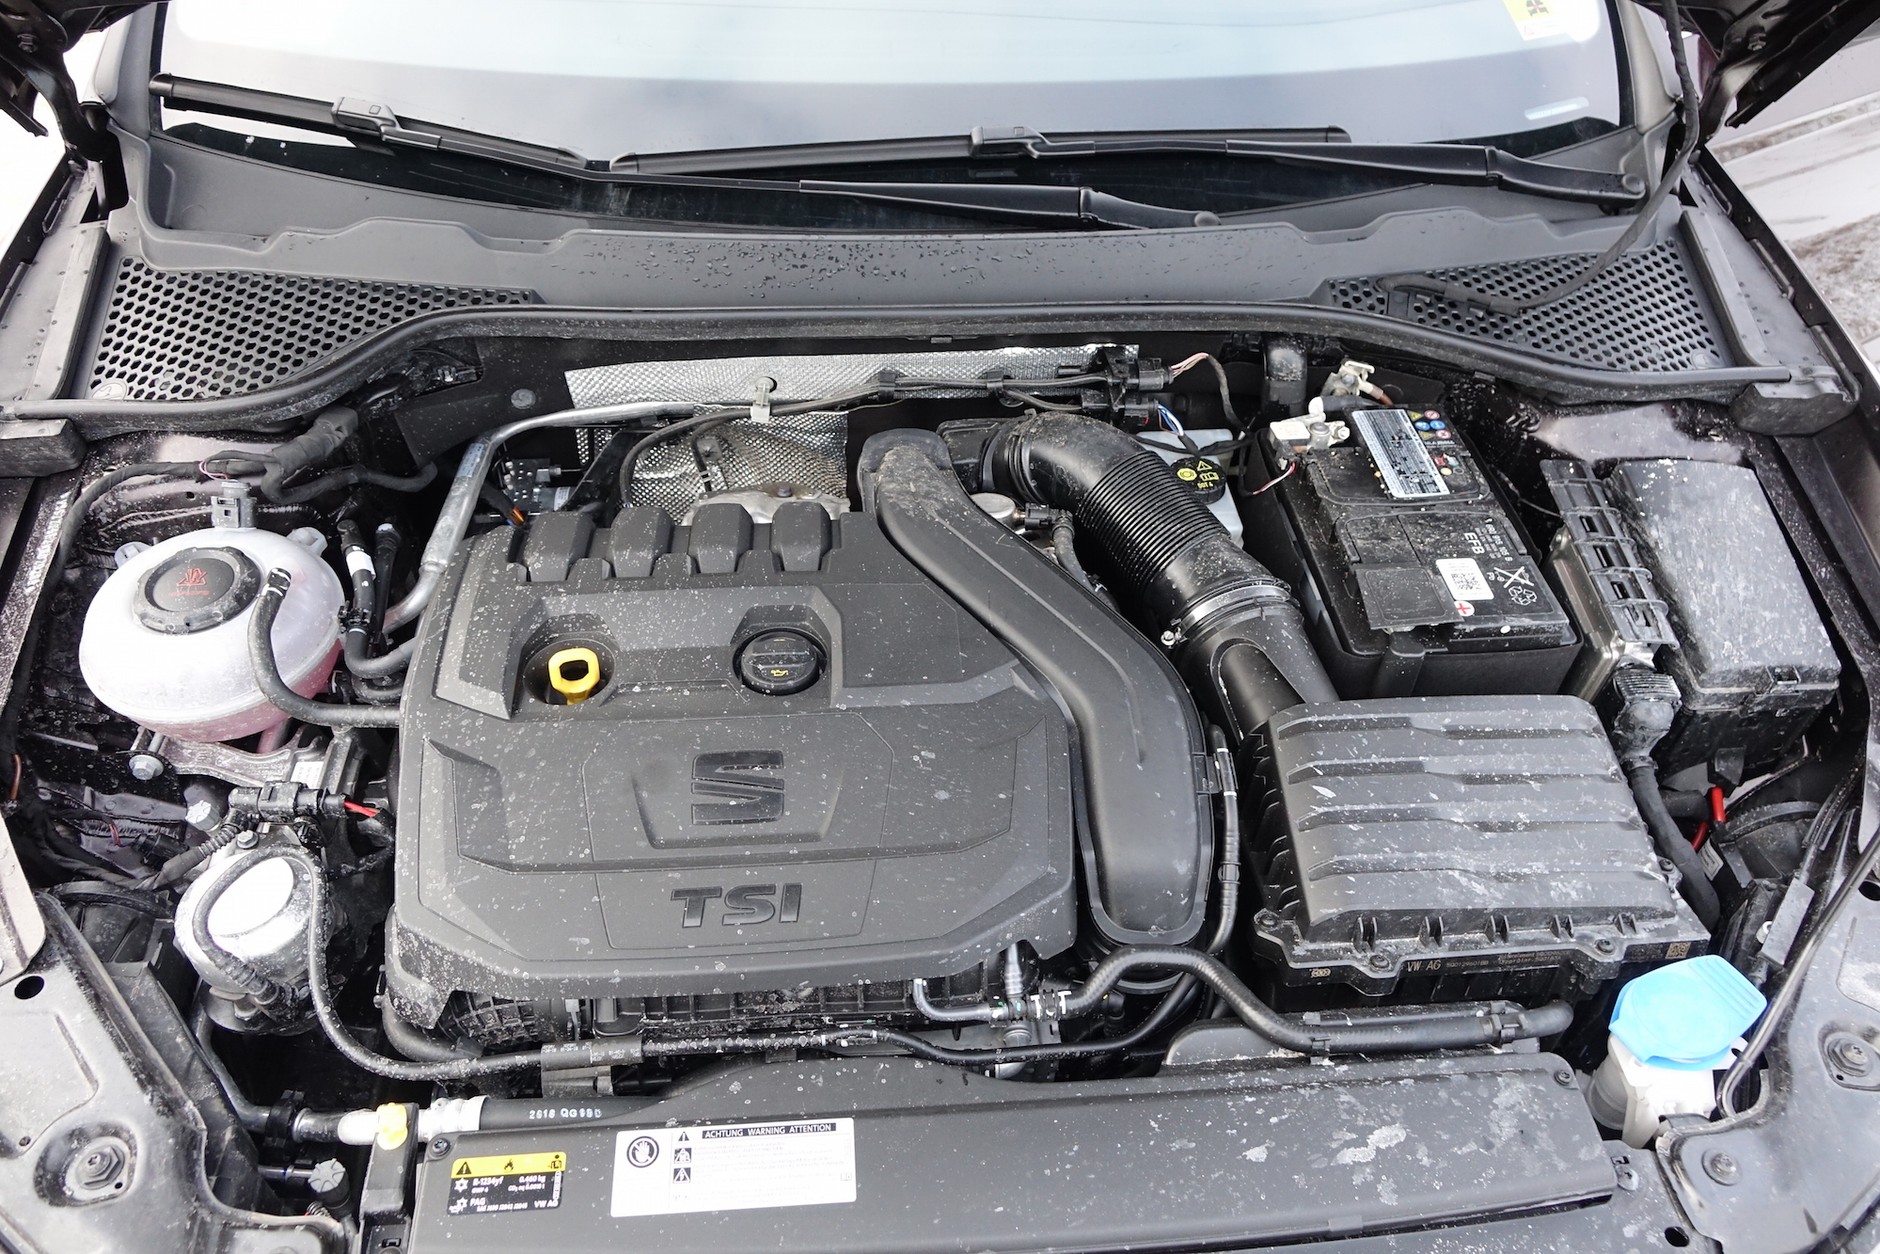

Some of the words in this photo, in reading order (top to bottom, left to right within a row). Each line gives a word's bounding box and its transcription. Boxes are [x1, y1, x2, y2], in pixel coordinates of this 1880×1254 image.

[1463, 532, 1485, 554] EFB
[670, 882, 802, 928] TSI
[1407, 961, 1423, 972] VW
[1426, 959, 1441, 970] AG
[704, 1128, 744, 1139] ACHTUNG
[747, 1126, 785, 1136] WARNING
[789, 1123, 832, 1134] ATTENTION
[470, 1197, 486, 1207] PAG
[534, 1200, 547, 1208] VW
